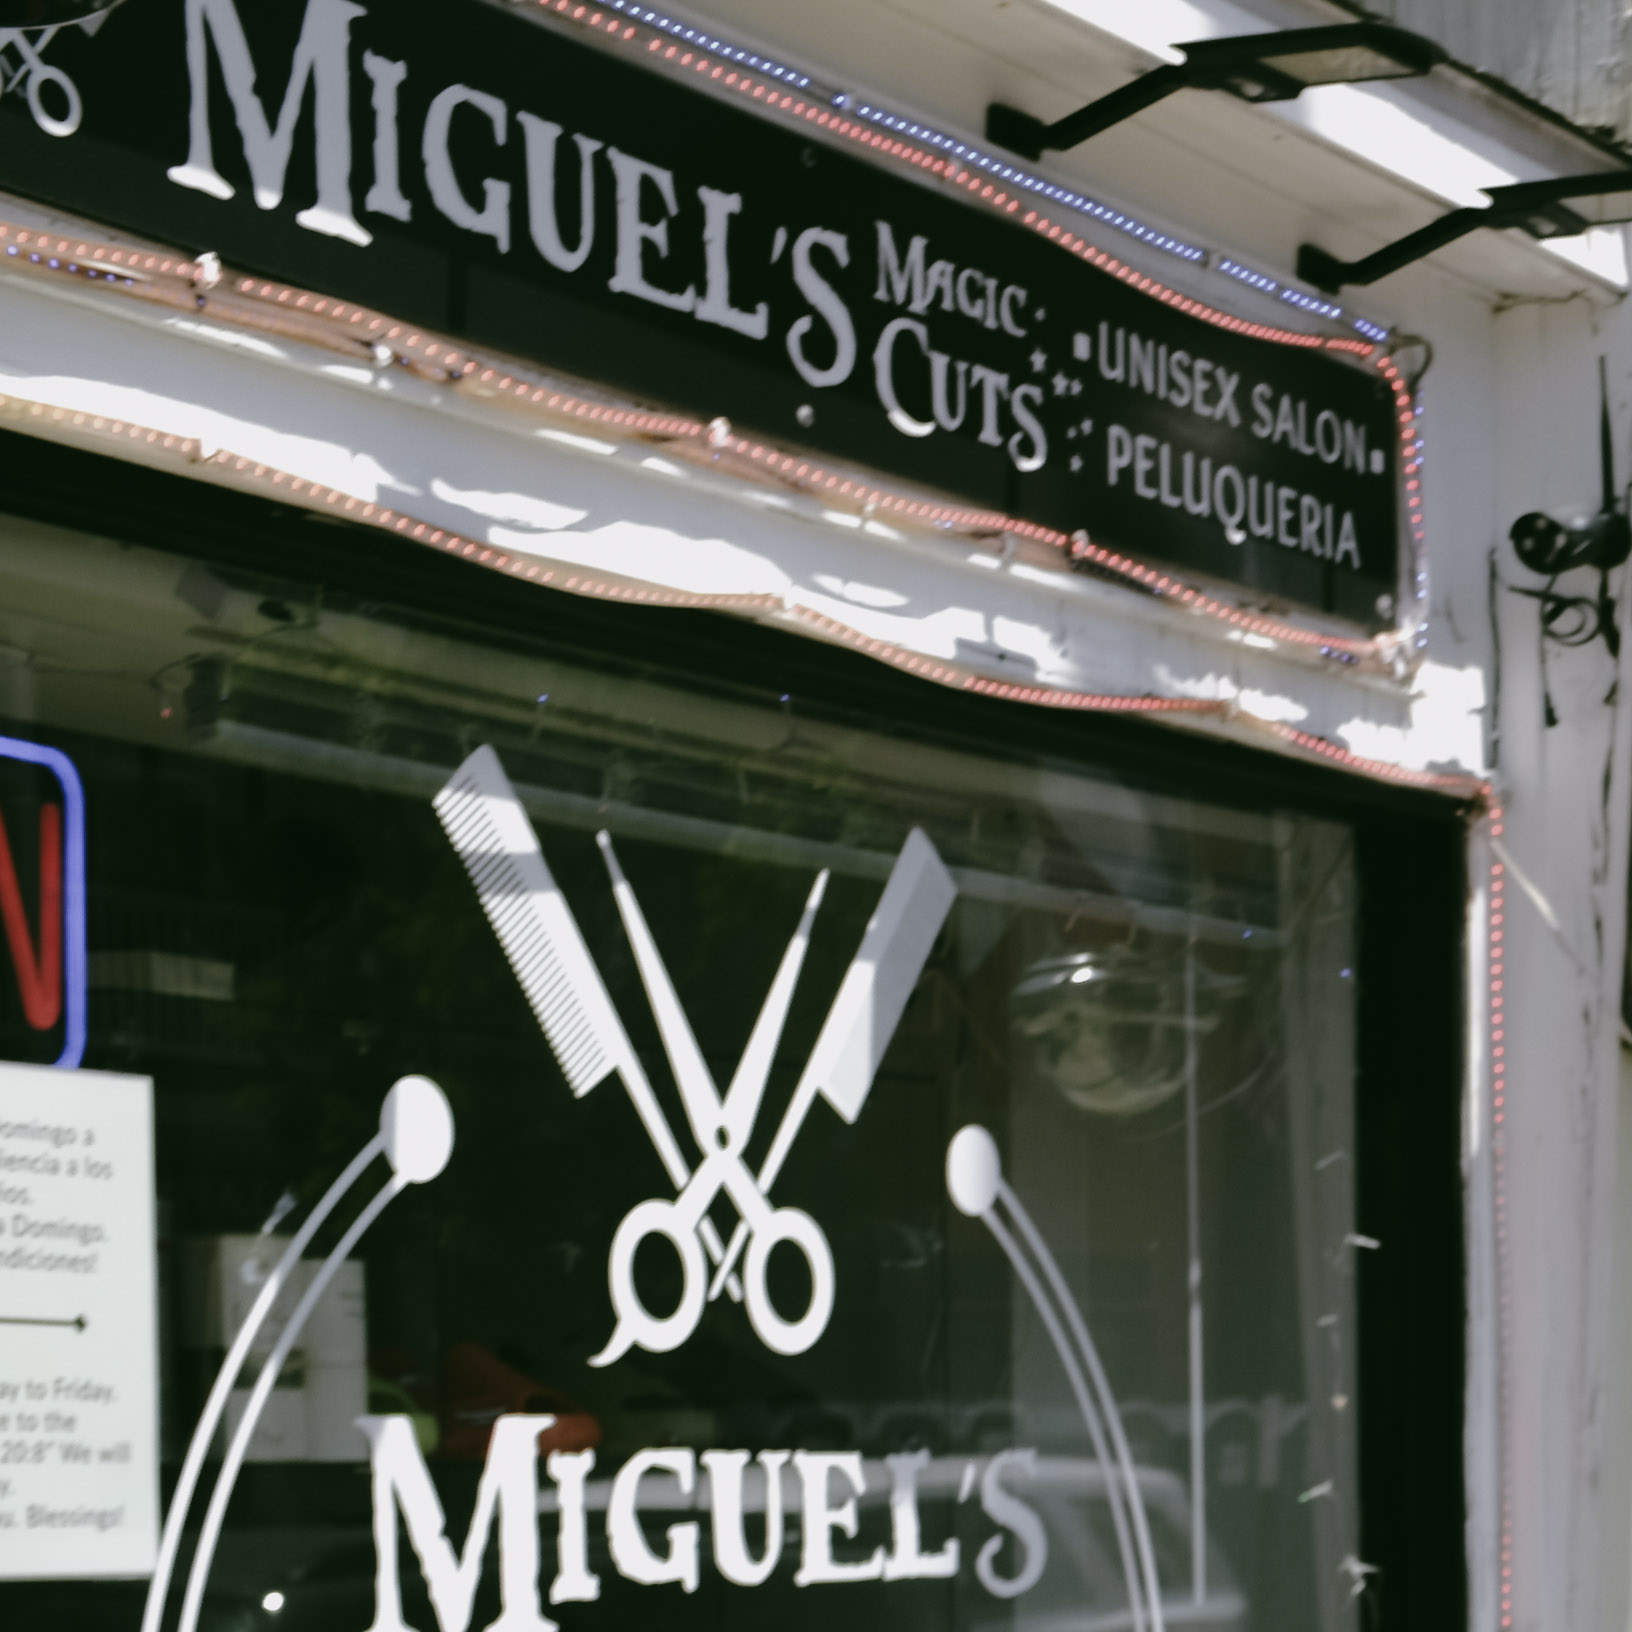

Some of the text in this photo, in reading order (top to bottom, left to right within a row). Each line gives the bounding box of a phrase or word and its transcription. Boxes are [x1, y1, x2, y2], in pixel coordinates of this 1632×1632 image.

[167, 0, 857, 388] MIGUEL'S
[874, 219, 1028, 338] MAGIC
[873, 316, 1049, 473] CUTS
[1099, 321, 1367, 474] UNISEX SALON
[1106, 423, 1362, 571] PELUQUERIA
[16, 1410, 39, 1433] to
[44, 1409, 78, 1434] the
[25, 1378, 49, 1401] to
[52, 1375, 119, 1406] Friday.
[58, 1442, 92, 1466] We
[98, 1441, 133, 1465] will
